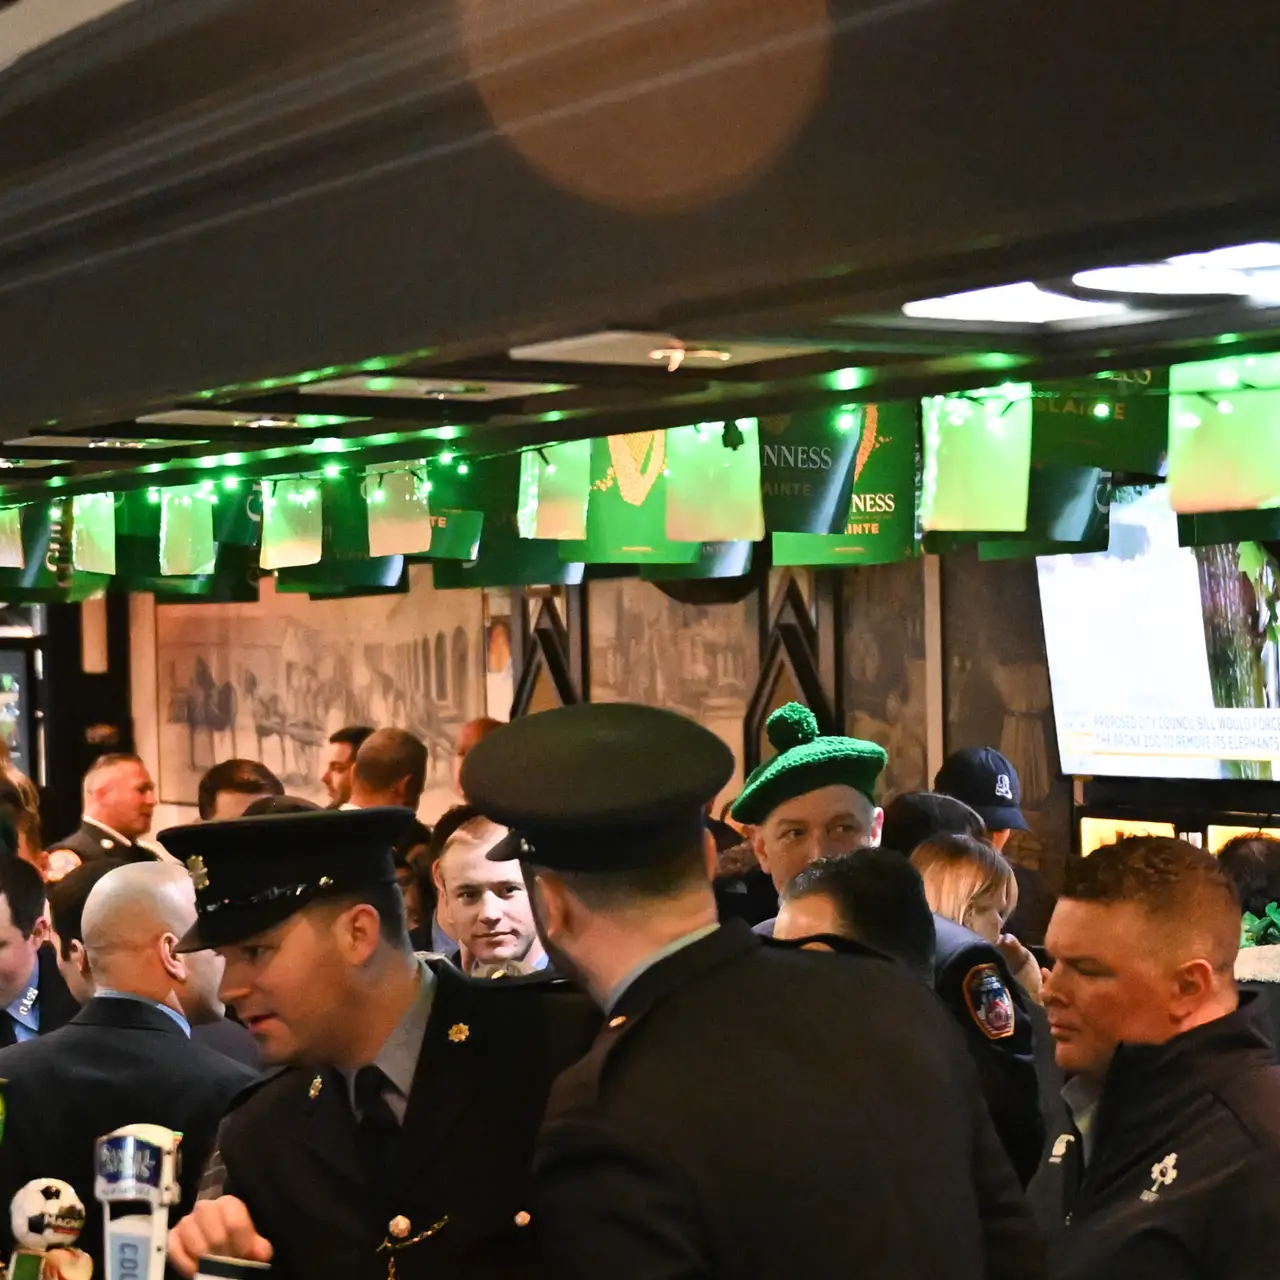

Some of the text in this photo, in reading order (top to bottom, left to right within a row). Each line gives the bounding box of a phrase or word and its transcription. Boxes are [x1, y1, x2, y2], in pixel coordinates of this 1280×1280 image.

[763, 444, 833, 470] NNESS
[851, 493, 896, 513] NESS
[846, 522, 880, 535] INTE
[1093, 715, 1137, 730] PROPOSED
[1139, 715, 1156, 730] CITY
[1158, 716, 1195, 731] COUNCIL
[1197, 716, 1216, 731] BILL
[1218, 716, 1251, 731] WOULD
[1143, 735, 1162, 749] ZOO
[1163, 735, 1174, 749] TO
[1176, 735, 1211, 750] REMOVE
[1213, 735, 1227, 750] ITS
[1228, 735, 1280, 751] ELEPHANTS
